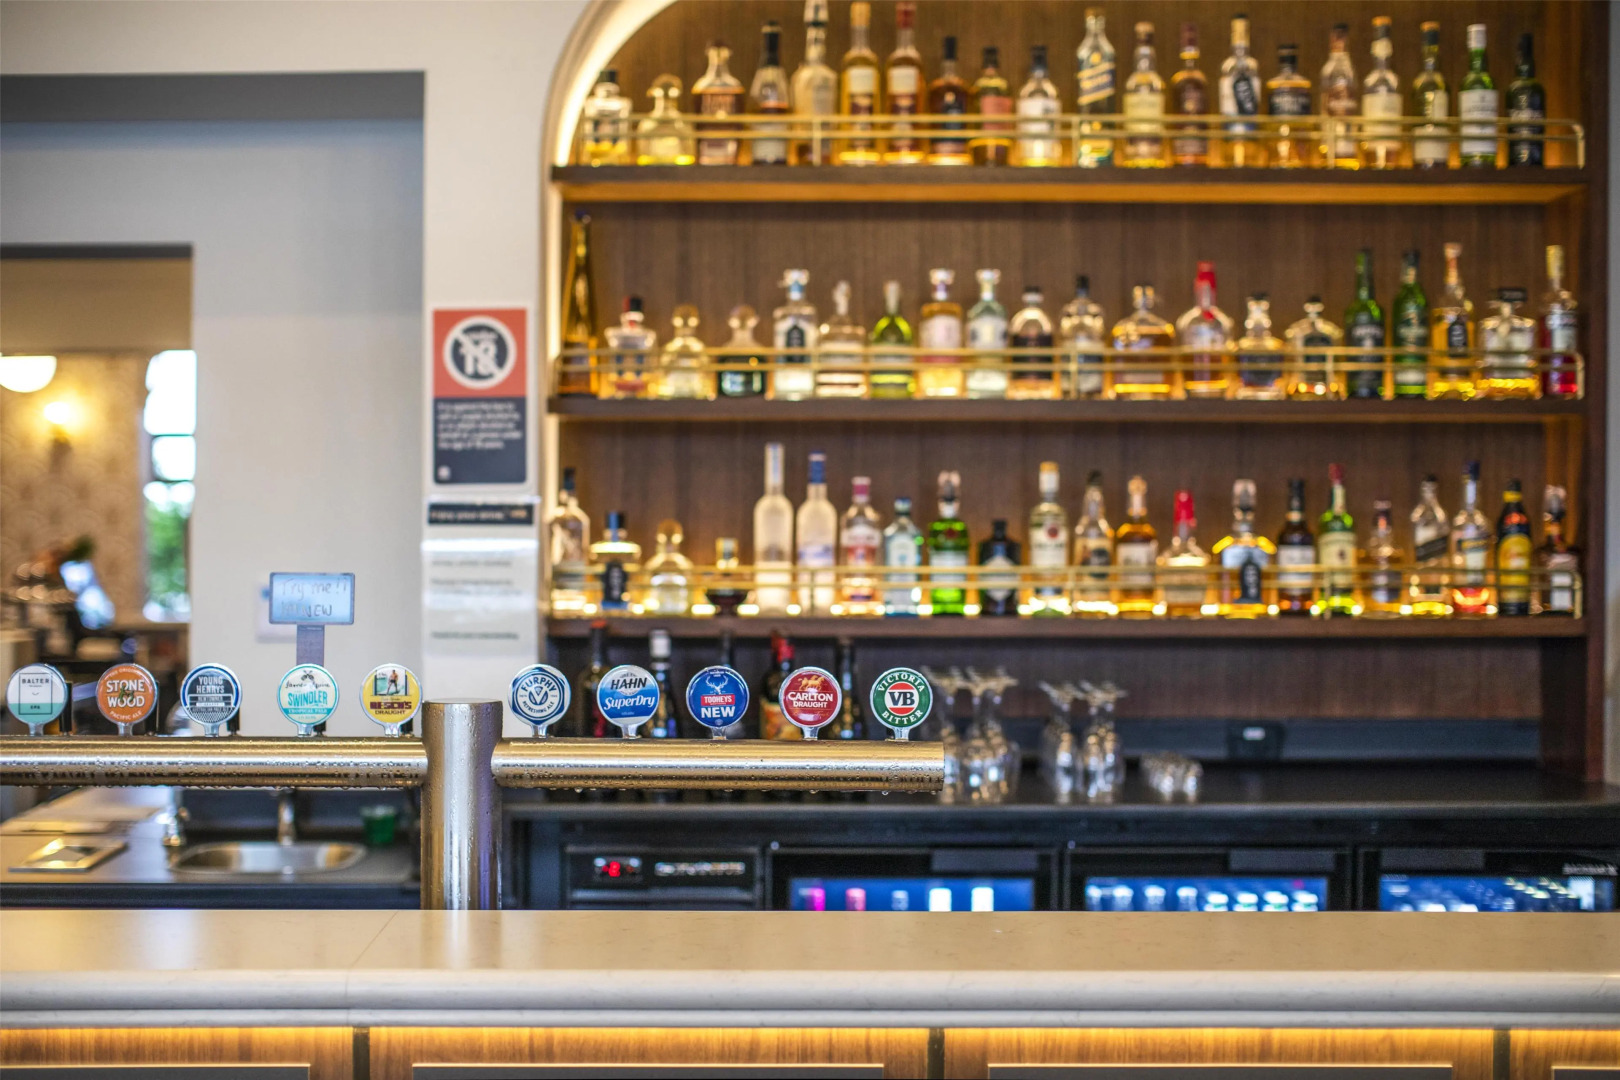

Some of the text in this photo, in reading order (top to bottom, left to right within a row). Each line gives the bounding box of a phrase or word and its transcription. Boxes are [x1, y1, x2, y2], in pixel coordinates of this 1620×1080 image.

[280, 577, 305, 601] Try
[302, 604, 333, 618] NEW
[106, 679, 145, 693] STONE
[198, 676, 224, 685] YOUNG
[520, 676, 557, 692] FURPHY
[610, 677, 648, 690] HAHN
[877, 673, 925, 692] VICTORIA
[196, 685, 225, 694] HENRYS
[107, 695, 145, 707] WOOD
[287, 690, 328, 707] SWINDLER
[603, 695, 656, 710] SuperDry
[703, 695, 733, 704] TOOHEYS
[787, 691, 834, 702] CARLTON
[887, 691, 916, 706] VB
[546, 701, 555, 710] ALE
[132, 710, 142, 719] ALE
[700, 706, 736, 719] NEW
[881, 709, 924, 725] BITTER
